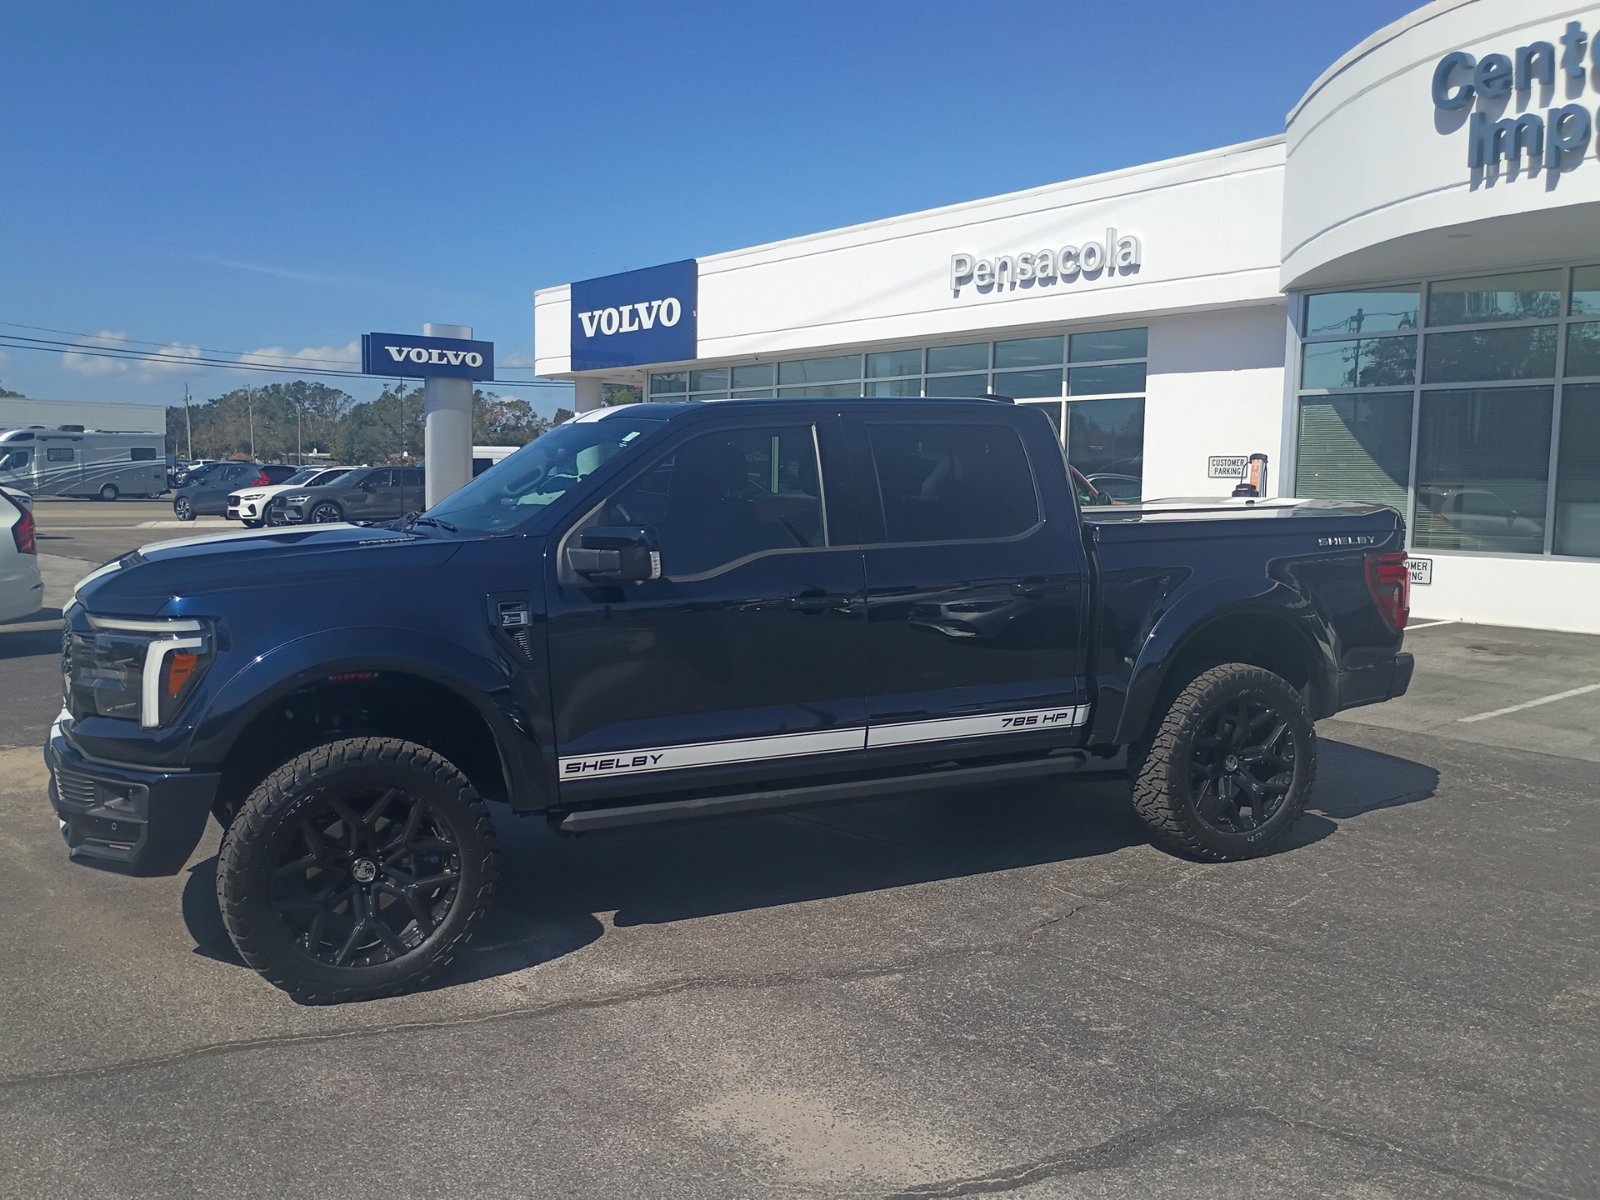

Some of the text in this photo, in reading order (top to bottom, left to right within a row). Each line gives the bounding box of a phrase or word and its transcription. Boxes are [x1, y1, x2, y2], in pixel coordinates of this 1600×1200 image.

[1431, 20, 1600, 112] Cent
[1467, 103, 1600, 169] Imp
[949, 226, 1142, 292] Pensacola
[577, 297, 682, 338] VOLVO
[384, 345, 484, 368] VOLVO
[1211, 458, 1245, 467] CUSTOMER
[1214, 467, 1242, 475] PARKING
[1318, 535, 1375, 547] SHELBY
[1001, 712, 1068, 728] 785 HP
[564, 753, 664, 774] SHELBY
